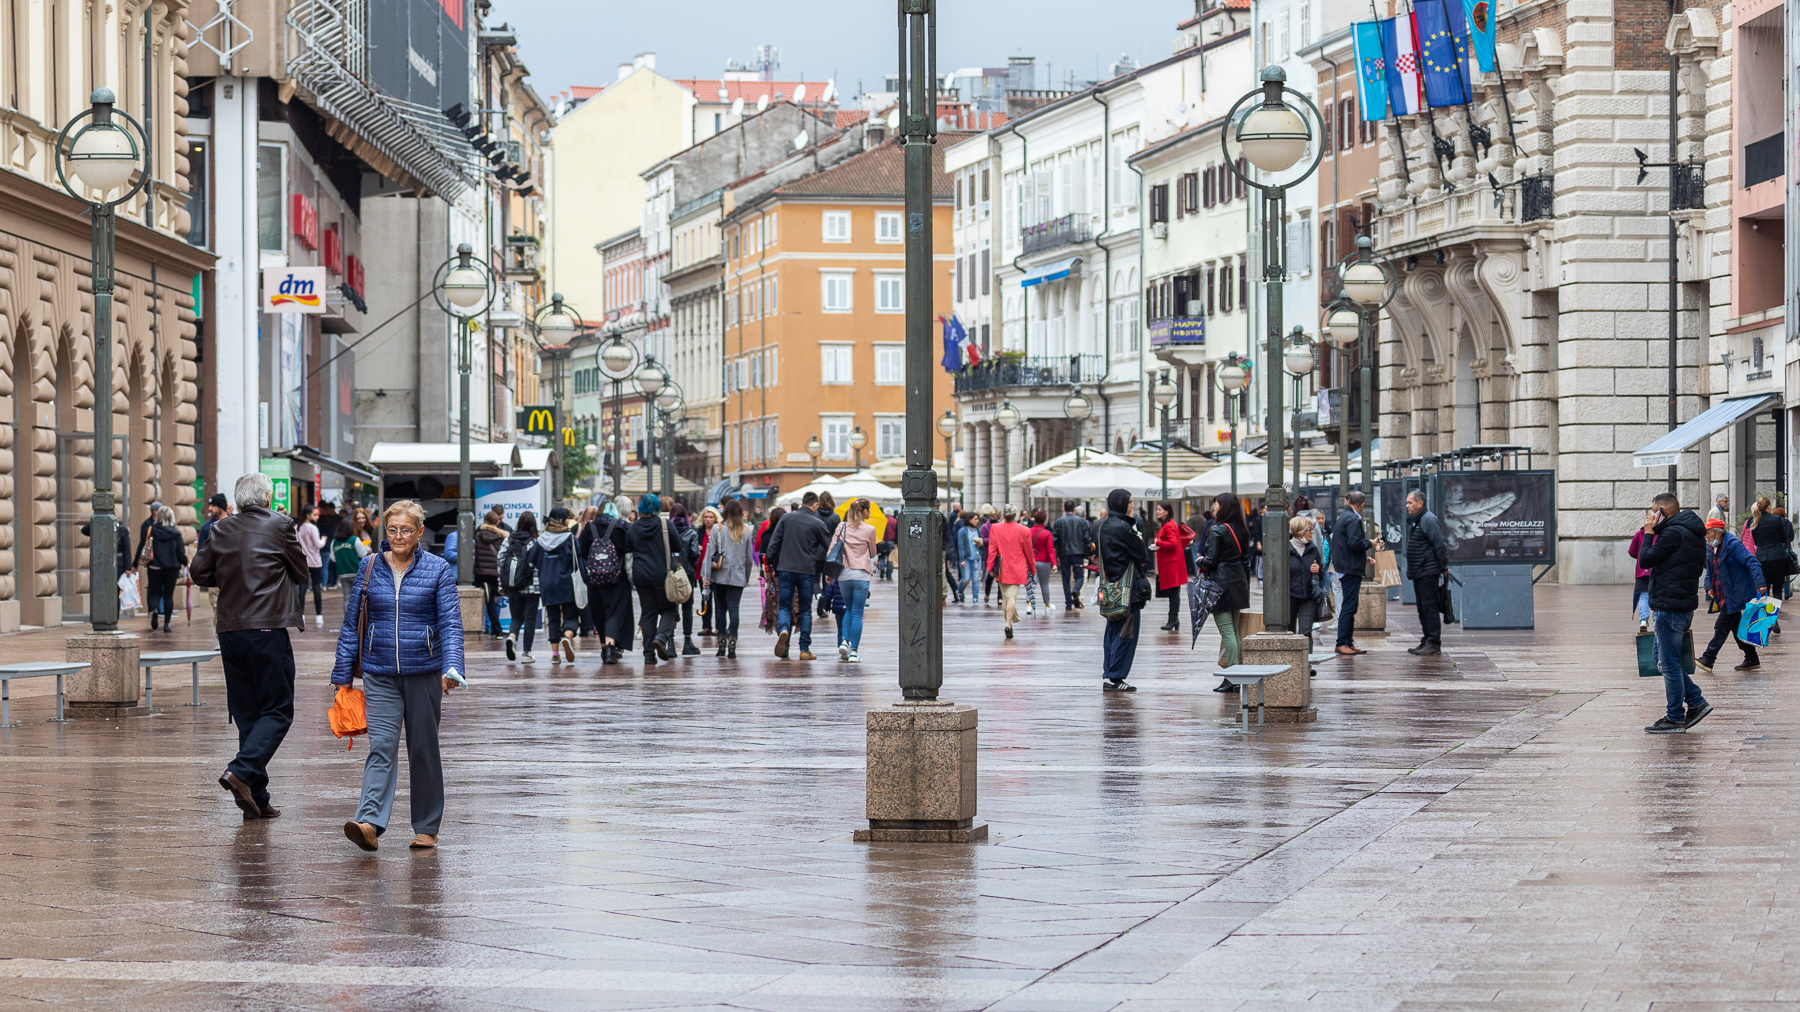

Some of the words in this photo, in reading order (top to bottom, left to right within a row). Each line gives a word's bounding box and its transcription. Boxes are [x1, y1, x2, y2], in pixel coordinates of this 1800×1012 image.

[279, 274, 314, 294] dm
[1174, 320, 1203, 328] HAPPY
[483, 502, 534, 511] MECINSKA
[1499, 520, 1545, 528] MICHELAZZI
